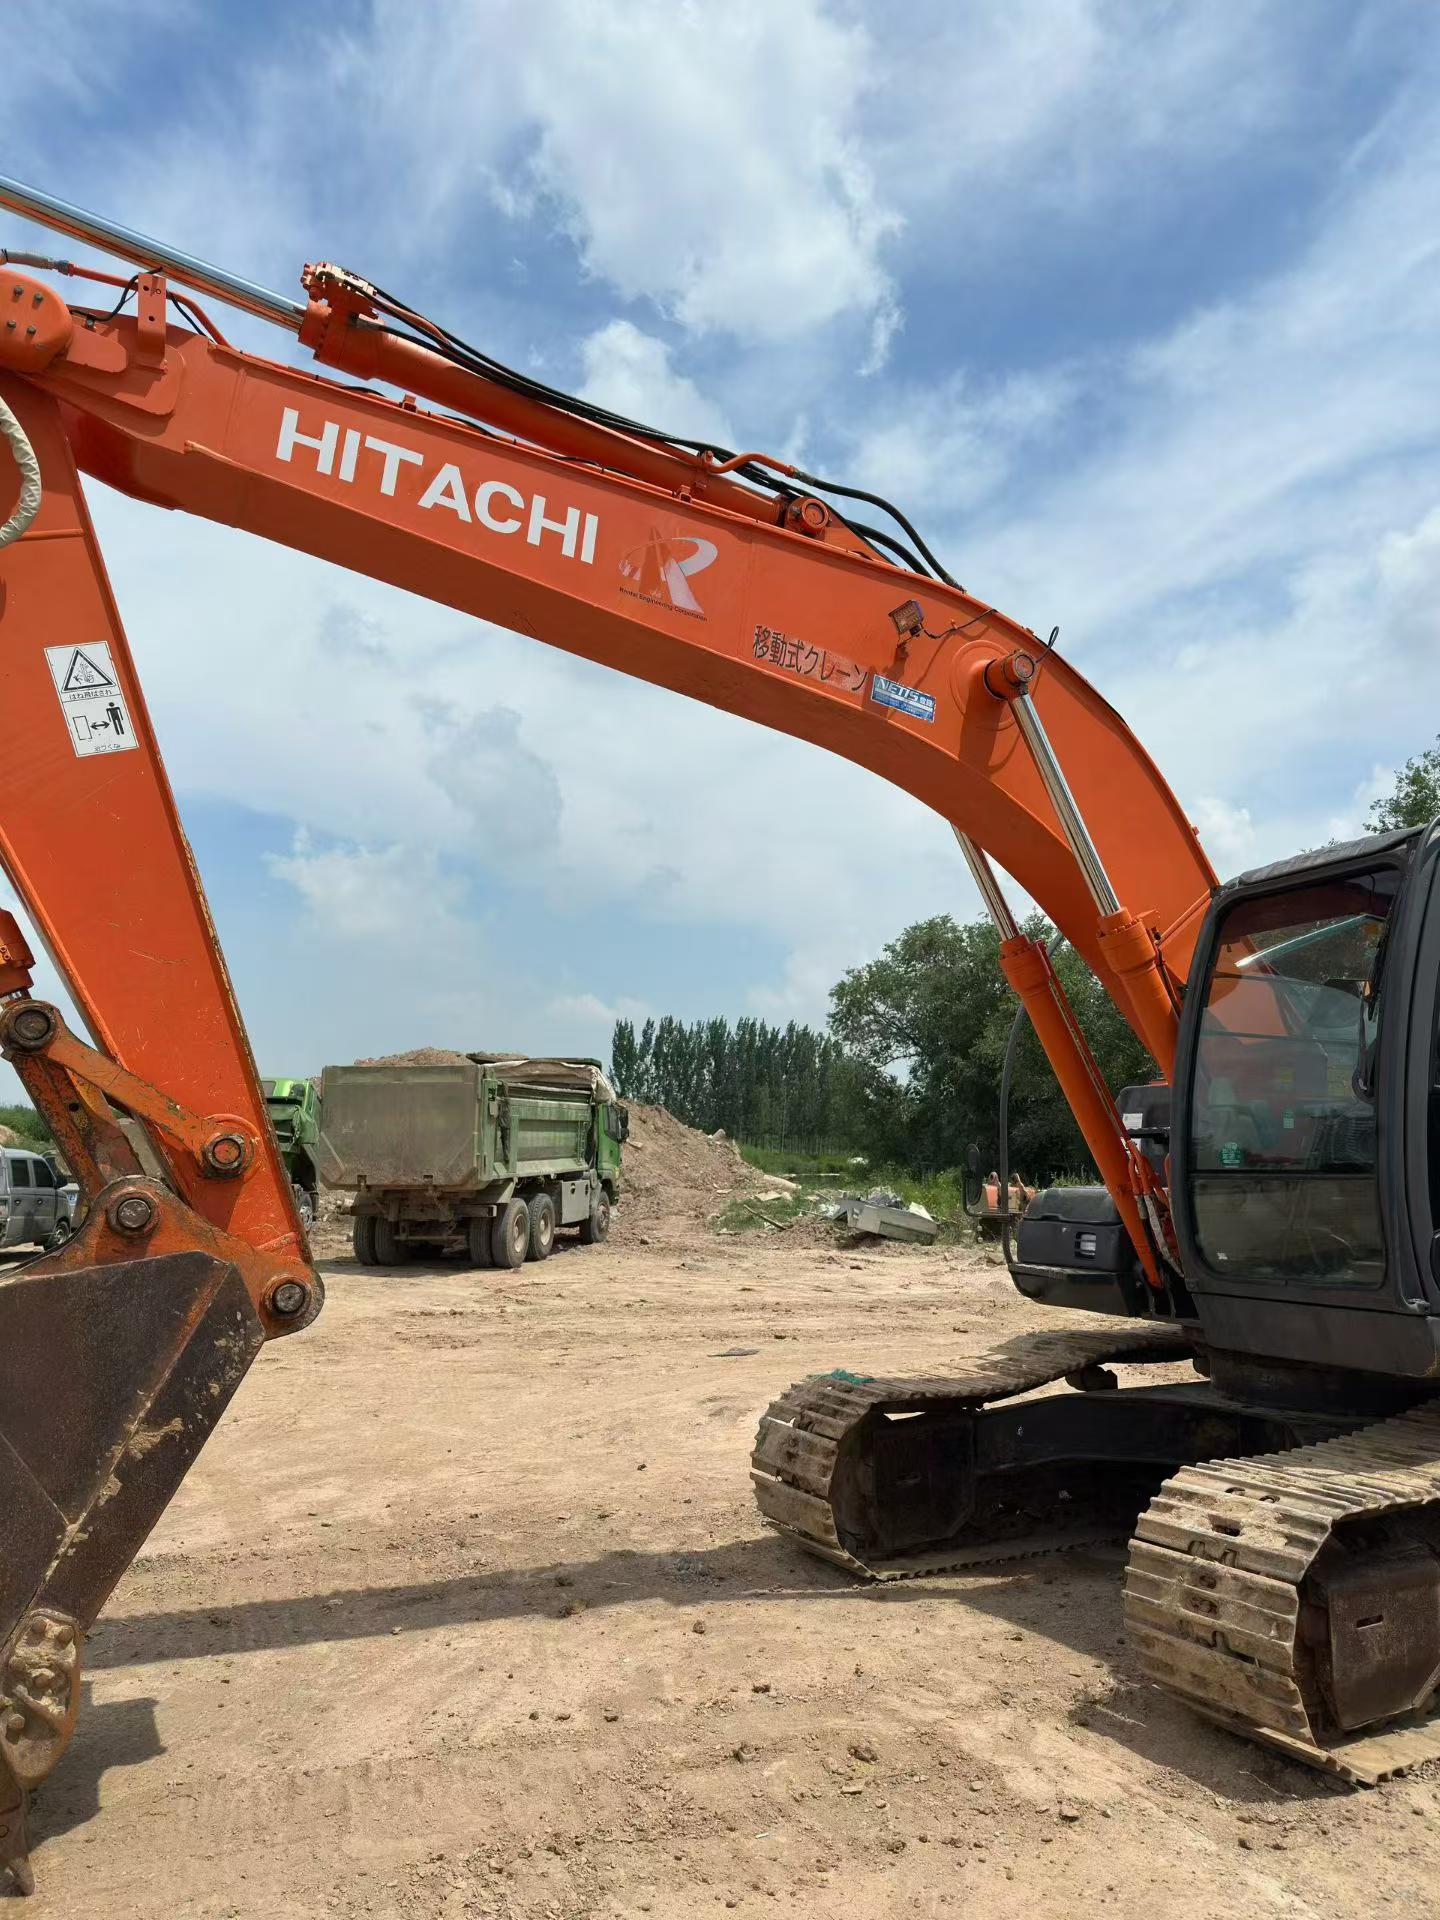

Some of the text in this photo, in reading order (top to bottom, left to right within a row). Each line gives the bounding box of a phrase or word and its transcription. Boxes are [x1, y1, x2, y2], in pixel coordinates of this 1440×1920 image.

[275, 407, 599, 564] HITACHI
[639, 593, 673, 611] Engineering
[674, 606, 708, 621] Corporation
[753, 625, 869, 691] 移動式クレーン
[877, 678, 919, 702] NETIS
